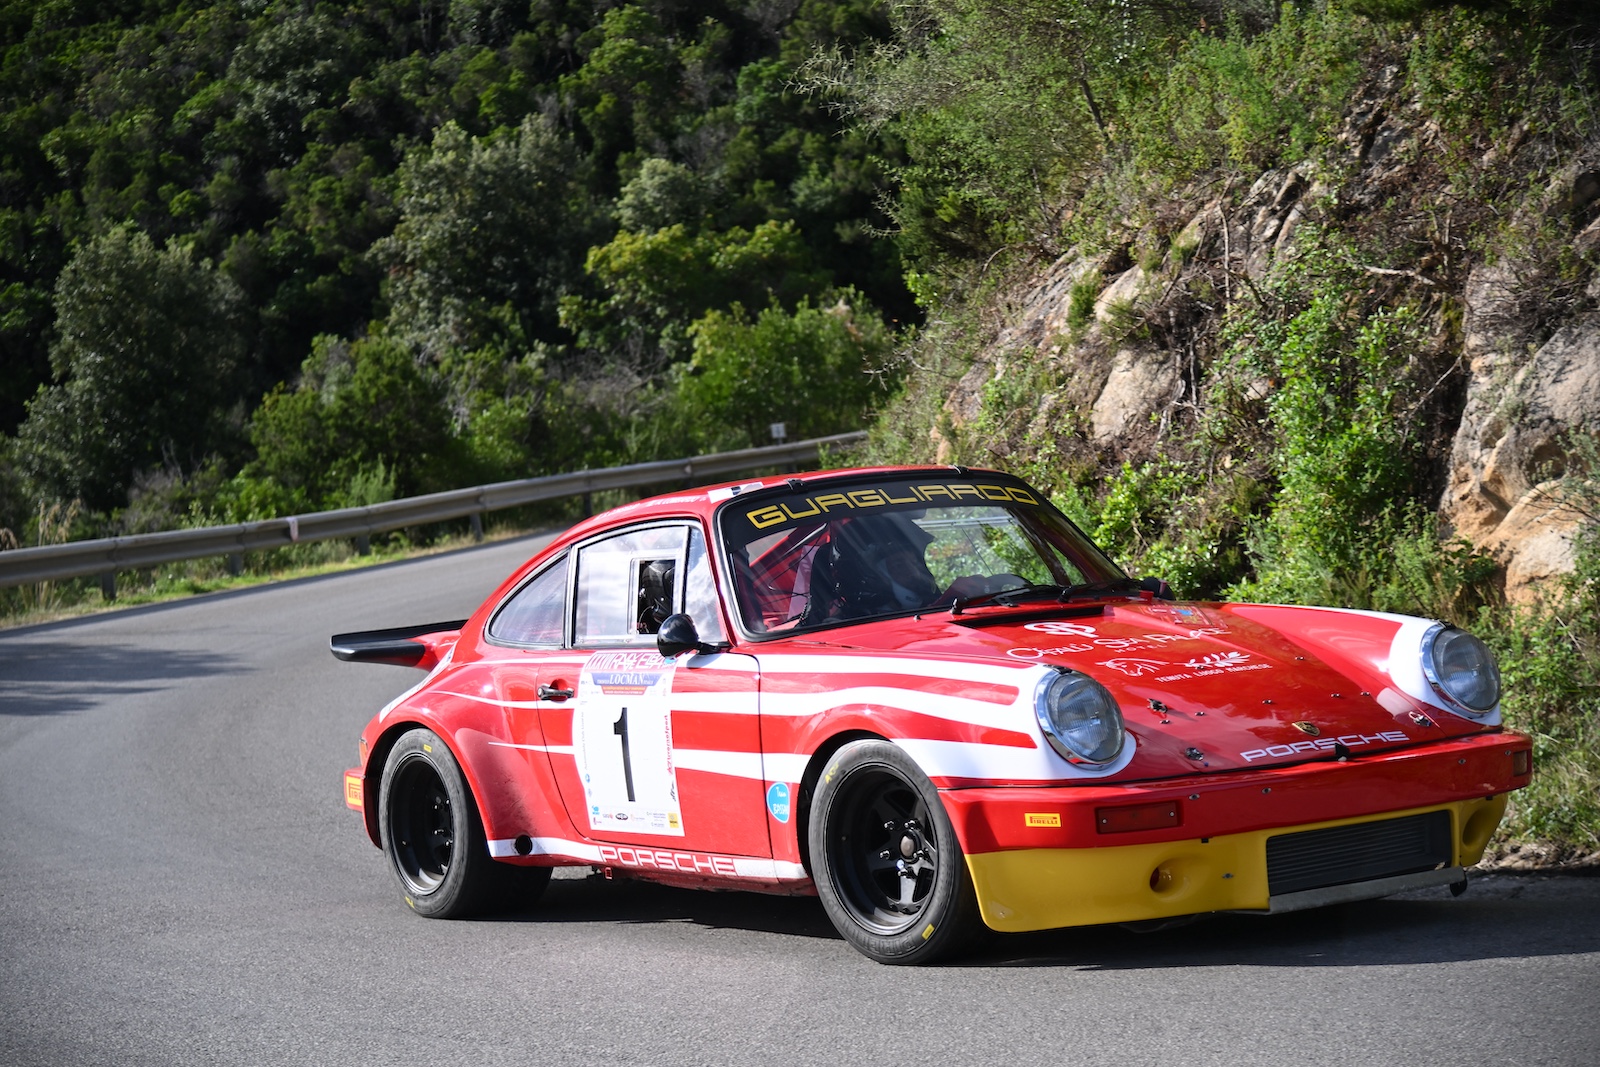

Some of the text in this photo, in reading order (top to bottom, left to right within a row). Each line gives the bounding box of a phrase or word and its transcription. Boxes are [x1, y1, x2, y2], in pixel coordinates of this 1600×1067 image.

[746, 484, 1040, 530] GUAGLIARDO
[609, 673, 644, 686] LOCMAN
[613, 707, 636, 803] 1
[1240, 730, 1411, 763] PORSCHE
[1029, 815, 1059, 826] PIRELLI
[600, 845, 738, 877] PORSCHE
